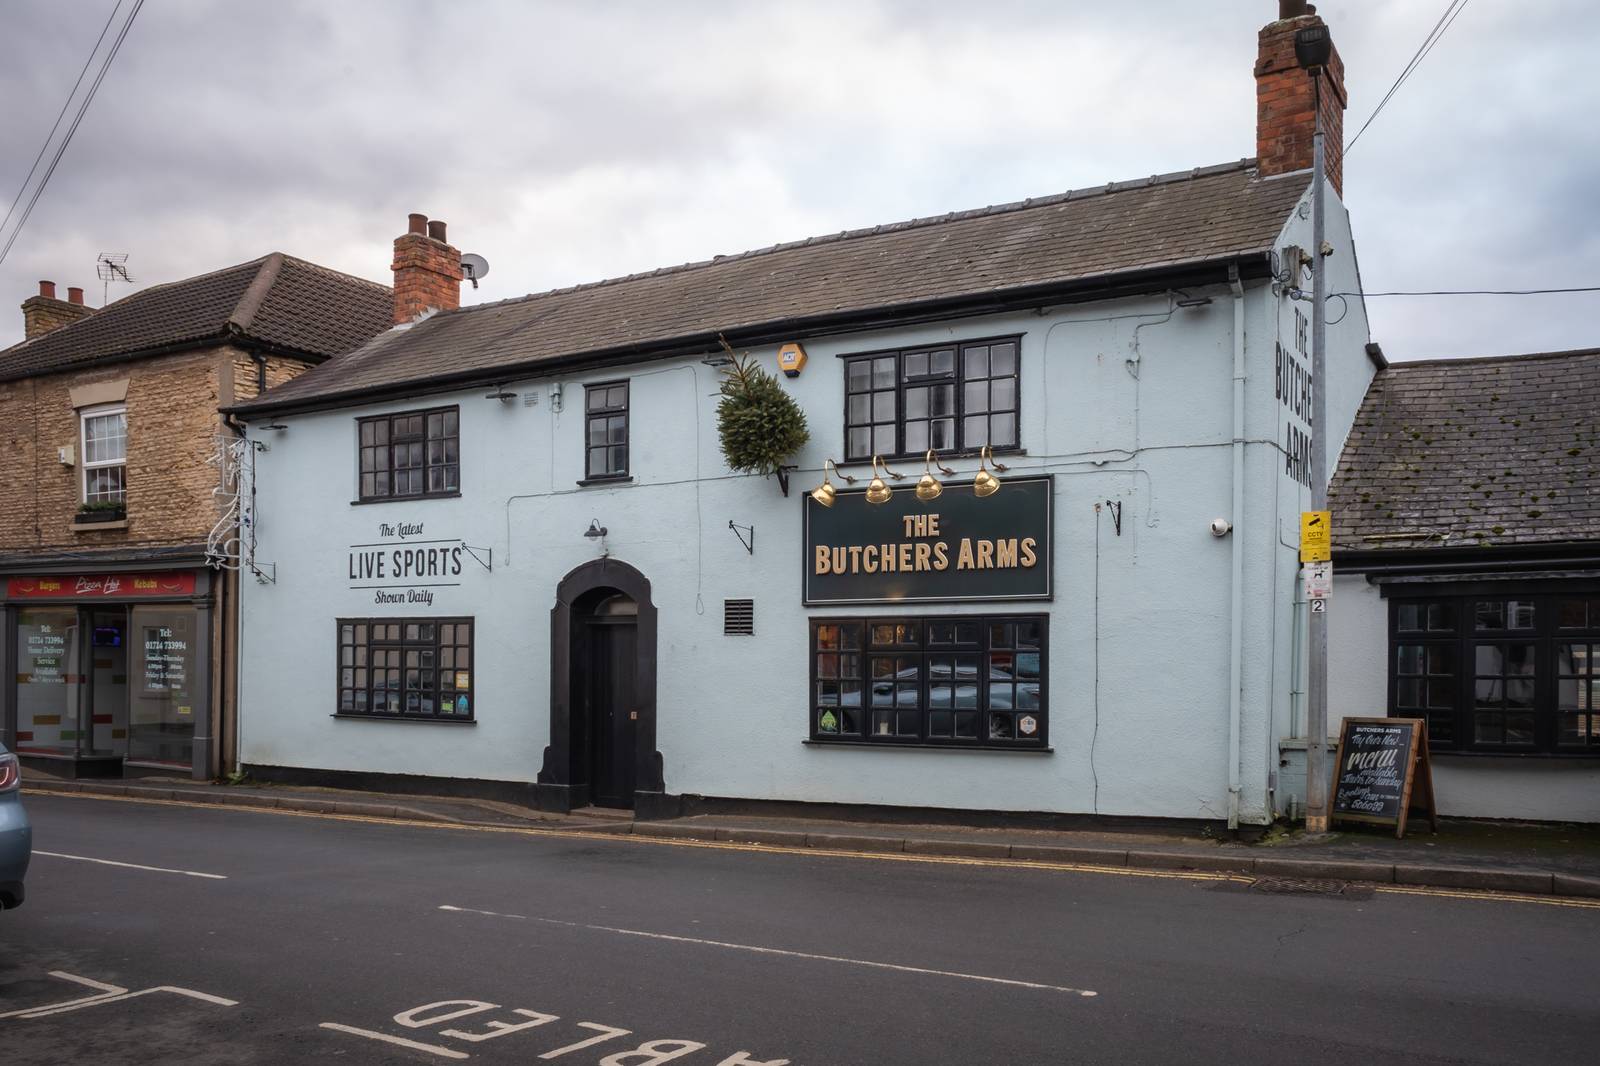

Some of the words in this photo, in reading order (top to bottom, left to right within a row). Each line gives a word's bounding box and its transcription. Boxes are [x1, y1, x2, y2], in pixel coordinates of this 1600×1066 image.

[1295, 306, 1308, 360] THE
[1275, 340, 1313, 428] BUTCHE
[379, 523, 394, 537] The
[397, 522, 424, 539] Latest
[902, 513, 940, 538] THE
[349, 551, 386, 579] LIVE
[392, 547, 462, 577] SPORTS
[815, 541, 949, 576] BUTCHERS
[957, 537, 1037, 571] ARMS
[75, 576, 102, 593] Pizza
[134, 580, 158, 590] Kebabs
[374, 589, 405, 605] Shown
[408, 589, 434, 606] Daily
[1314, 600, 1323, 612] 2
[160, 629, 172, 637] Tel:
[37, 657, 56, 665] Service
